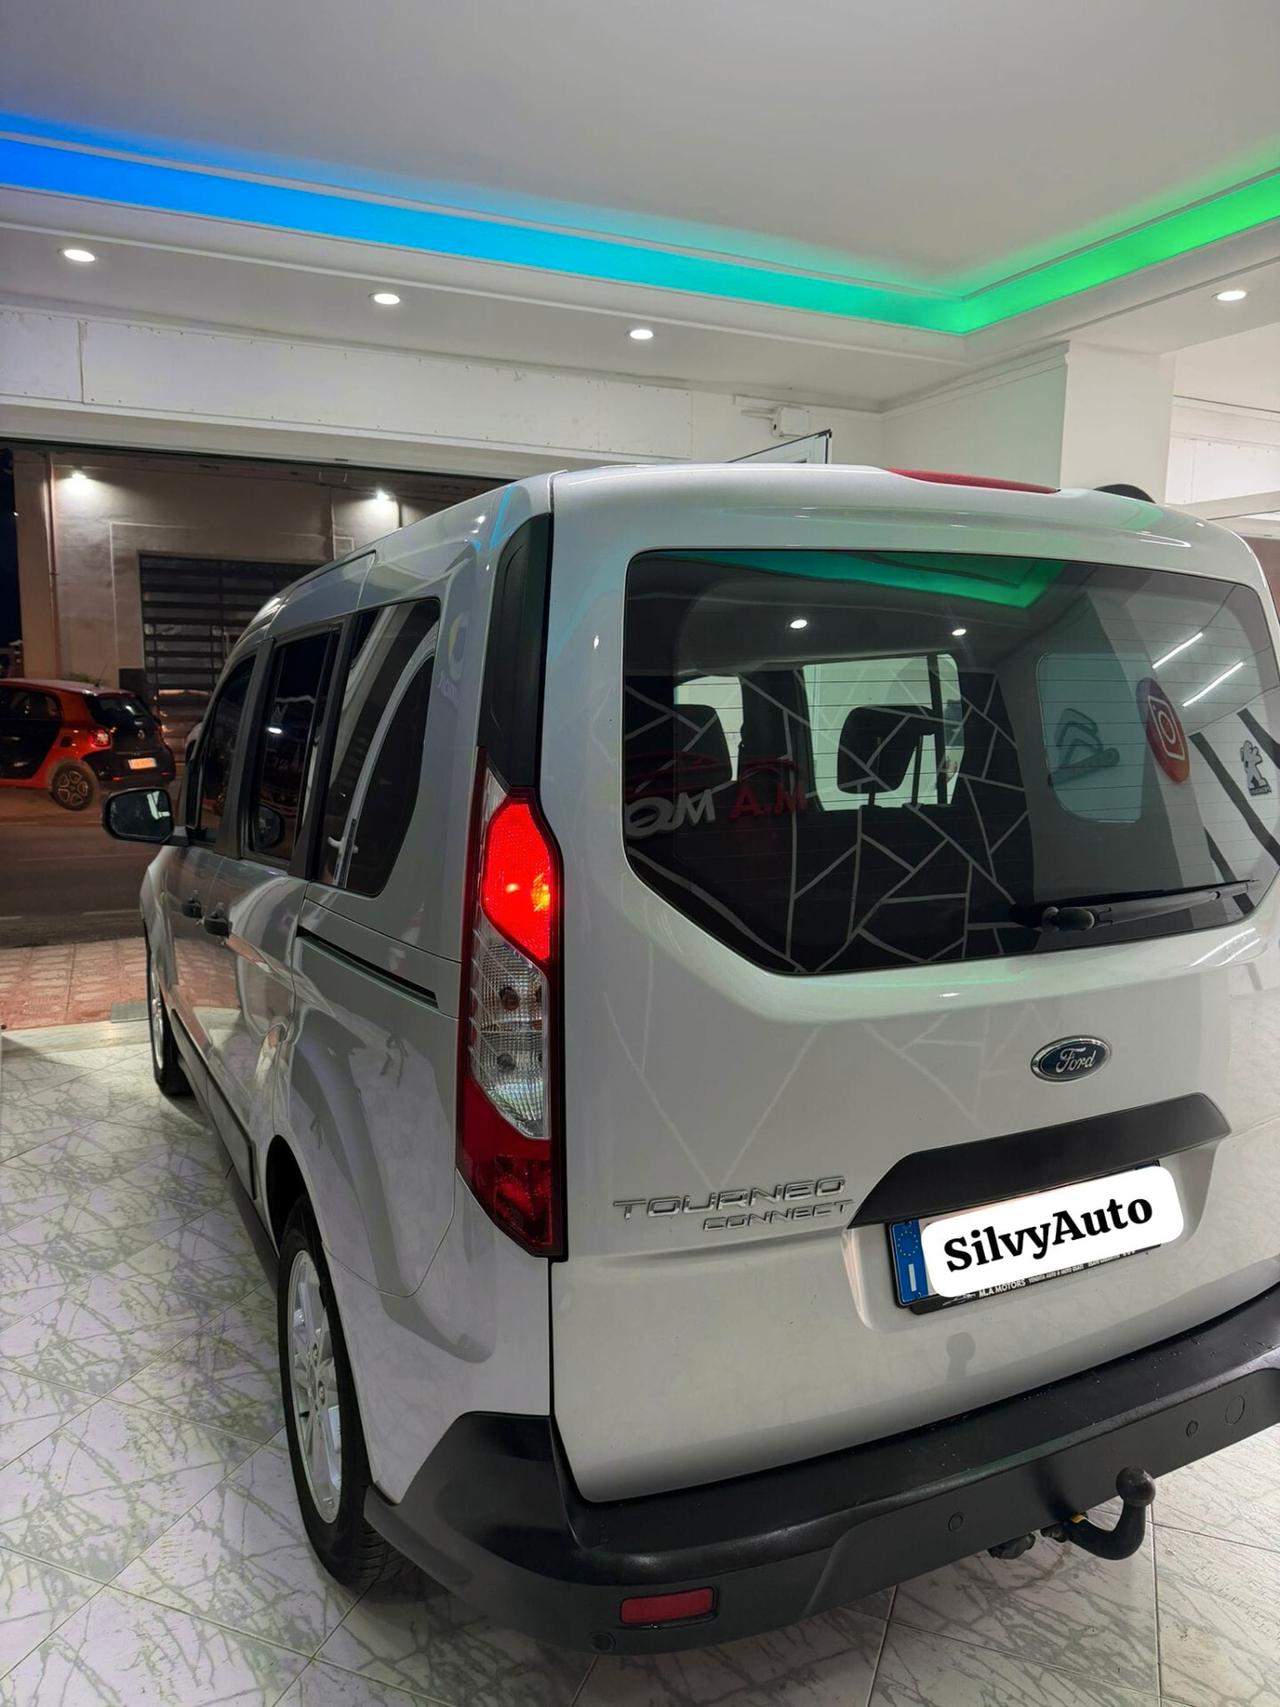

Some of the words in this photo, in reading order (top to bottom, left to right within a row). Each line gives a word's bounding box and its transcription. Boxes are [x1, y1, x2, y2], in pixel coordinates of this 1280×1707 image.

[1055, 1046, 1097, 1073] Ford
[613, 1175, 846, 1221] TOURNEO
[703, 1199, 853, 1231] CONNECT
[995, 1279, 1026, 1294] MOTORS
